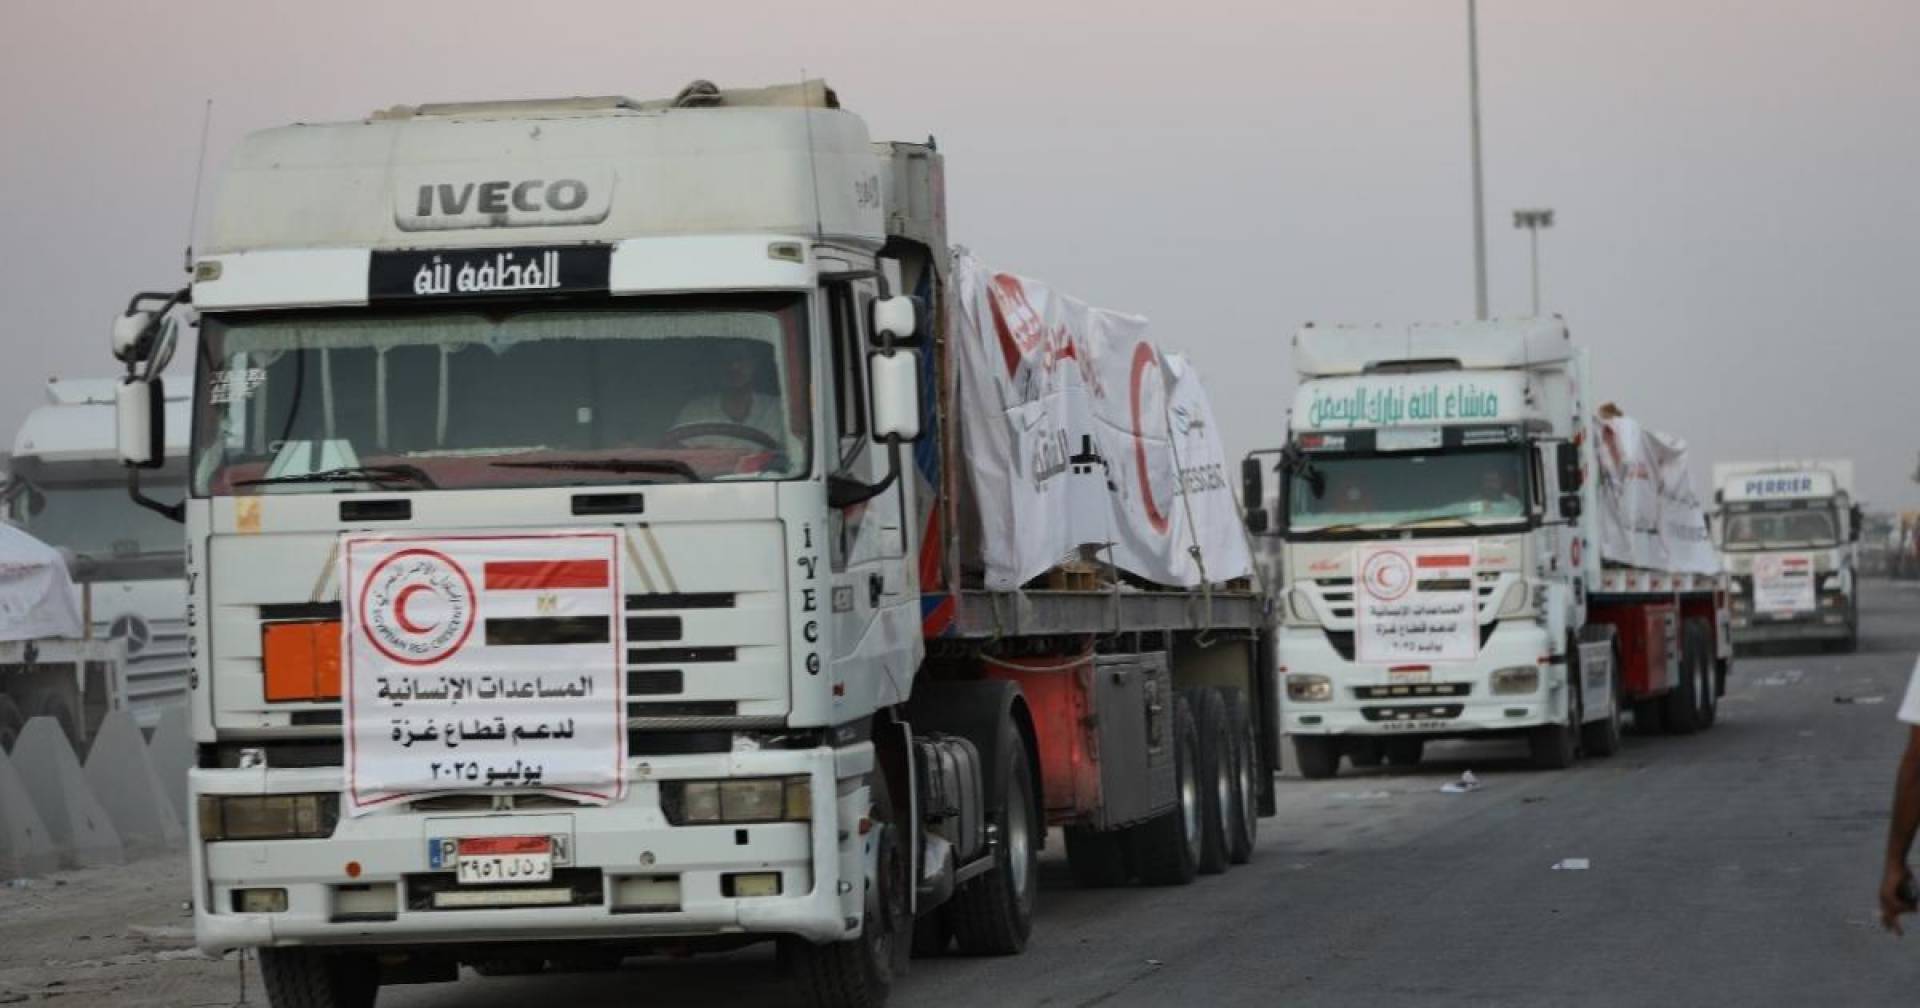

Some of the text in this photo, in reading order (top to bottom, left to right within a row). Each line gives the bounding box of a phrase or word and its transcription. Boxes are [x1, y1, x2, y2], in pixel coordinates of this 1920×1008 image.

[416, 179, 588, 216] IVECO
[413, 255, 450, 294] لله
[1408, 384, 1438, 420] الله
[1746, 477, 1811, 495] PERRIER
[377, 675, 593, 706] المساعدات الإنسانية
[391, 716, 574, 748] لدعم قطاع غزة
[431, 760, 542, 786] يوليو ٢٠٢٥
